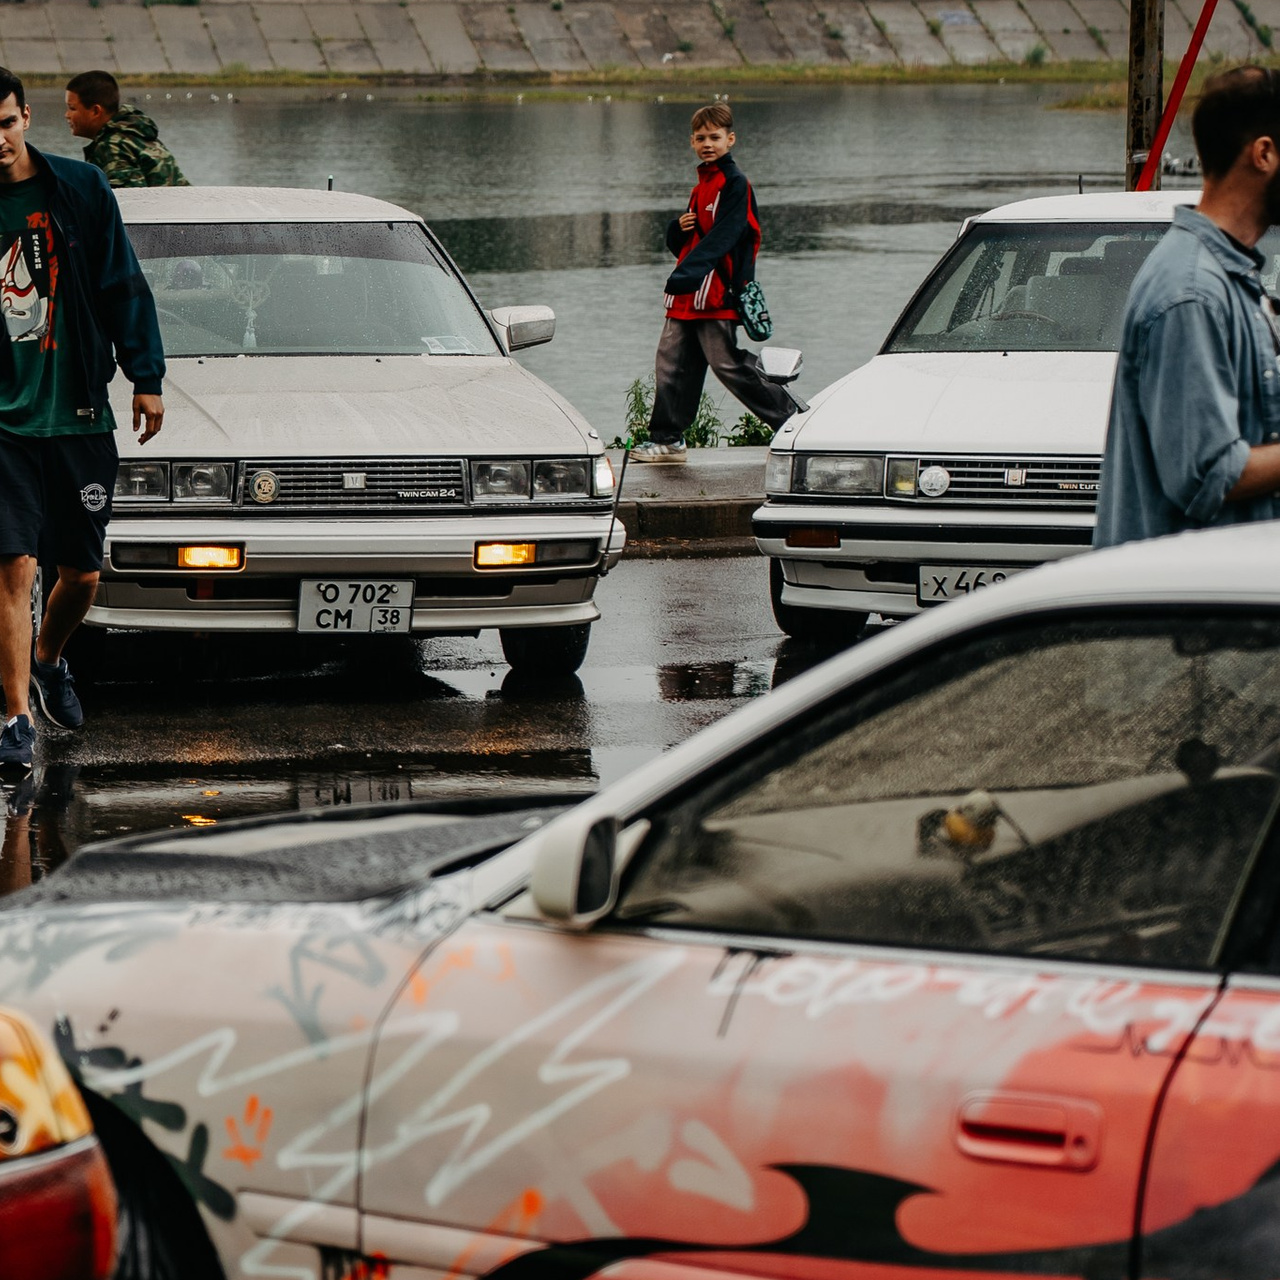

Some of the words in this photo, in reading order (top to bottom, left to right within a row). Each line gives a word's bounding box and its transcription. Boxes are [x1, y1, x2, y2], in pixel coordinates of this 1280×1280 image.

[439, 489, 456, 497] 24
[316, 609, 353, 629] СМ
[377, 609, 400, 625] 38
